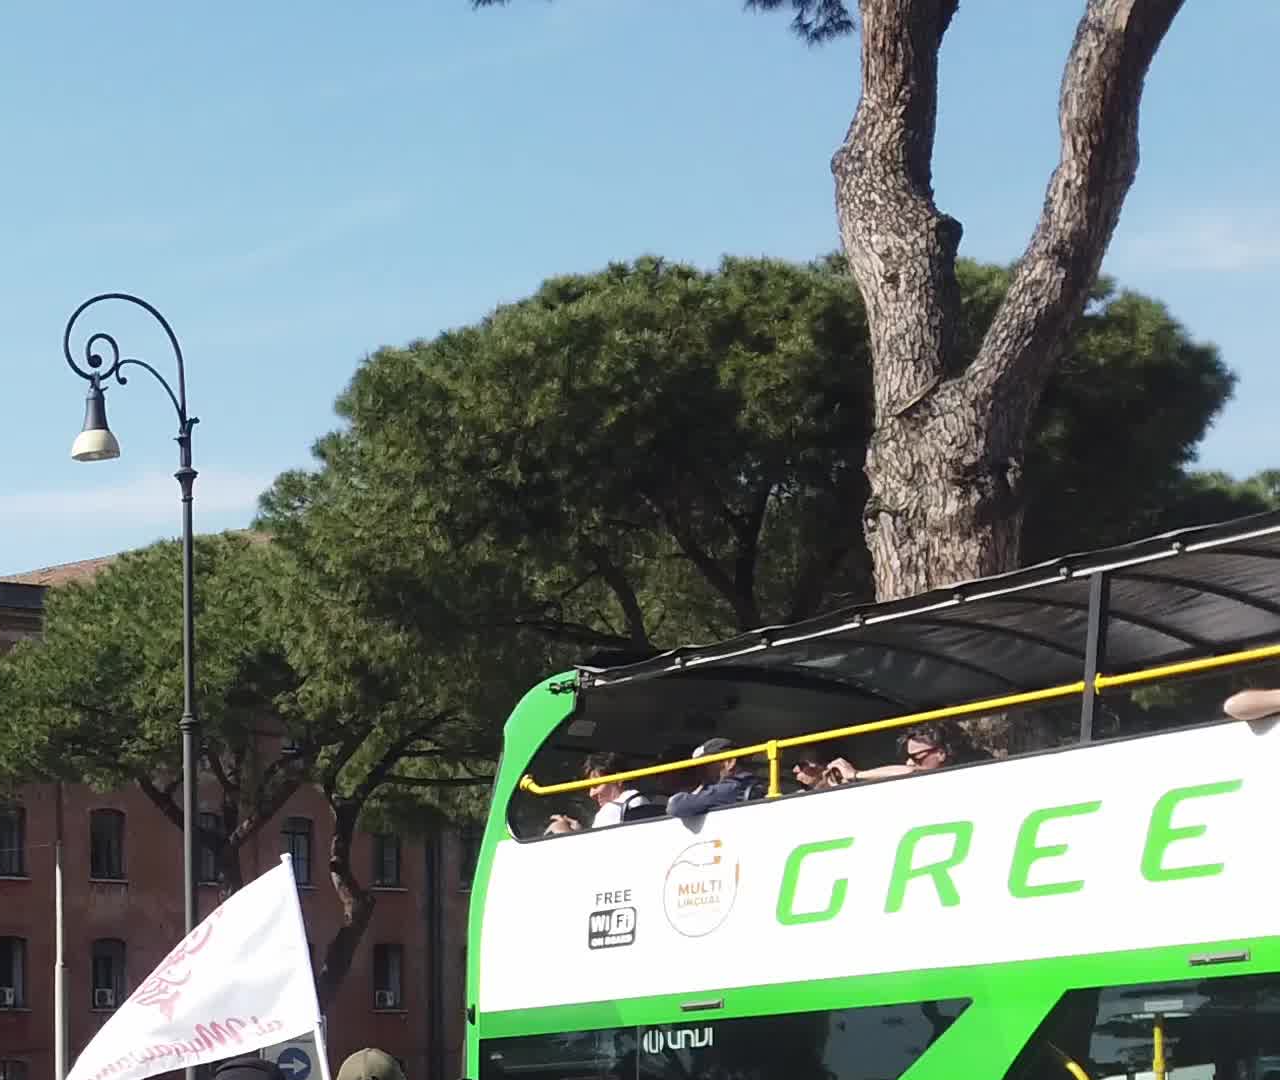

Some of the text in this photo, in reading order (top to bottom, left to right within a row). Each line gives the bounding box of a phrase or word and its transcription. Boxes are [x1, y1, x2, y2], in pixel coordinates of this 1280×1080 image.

[776, 778, 1244, 926] GREE
[679, 880, 722, 896] MULTI
[595, 889, 632, 905] FREE
